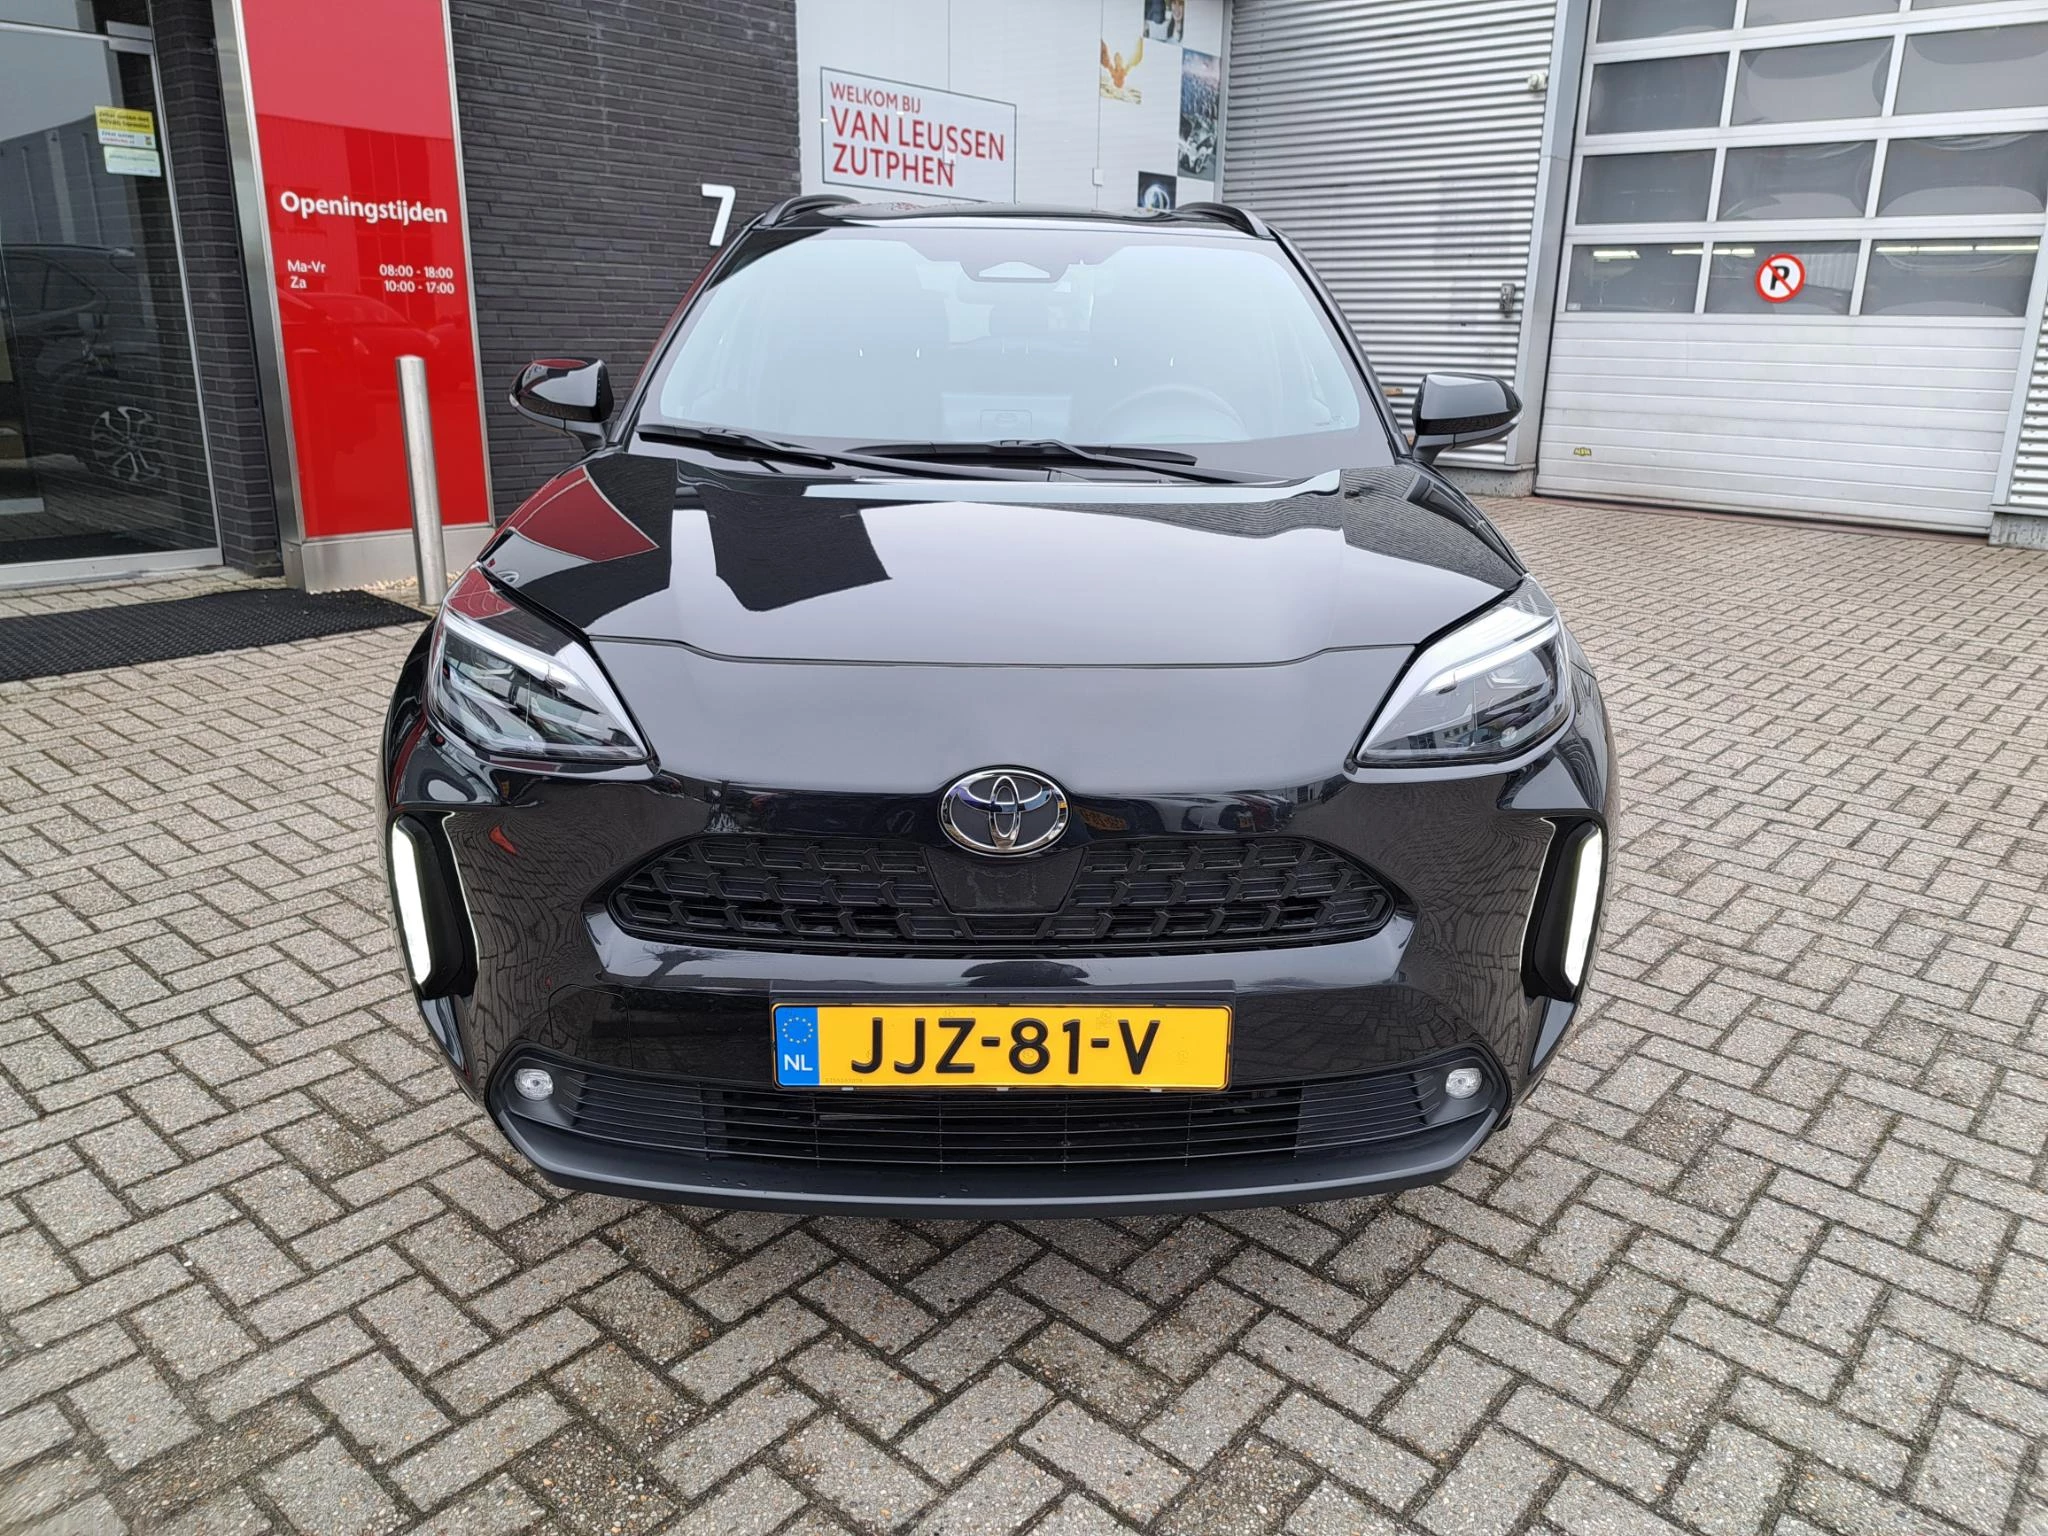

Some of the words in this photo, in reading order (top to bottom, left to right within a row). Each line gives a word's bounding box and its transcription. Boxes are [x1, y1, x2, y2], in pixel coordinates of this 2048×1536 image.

[830, 82, 898, 109] WELKOM
[902, 96, 921, 114] BIJ
[831, 105, 889, 144] VAN
[899, 117, 1005, 161] LEUSSEN
[832, 143, 955, 187] ZUTPHEN
[280, 191, 448, 225] Openingstijden
[701, 183, 736, 246] 7
[287, 260, 326, 273] Ma-Vr
[379, 264, 413, 276] 08:00
[424, 267, 453, 278] 18:00
[290, 276, 307, 289] Za
[384, 280, 415, 292] 10:00
[427, 282, 455, 294] 17:00
[850, 1017, 1160, 1075] JJZ-81-V
[784, 1055, 813, 1072] NL
